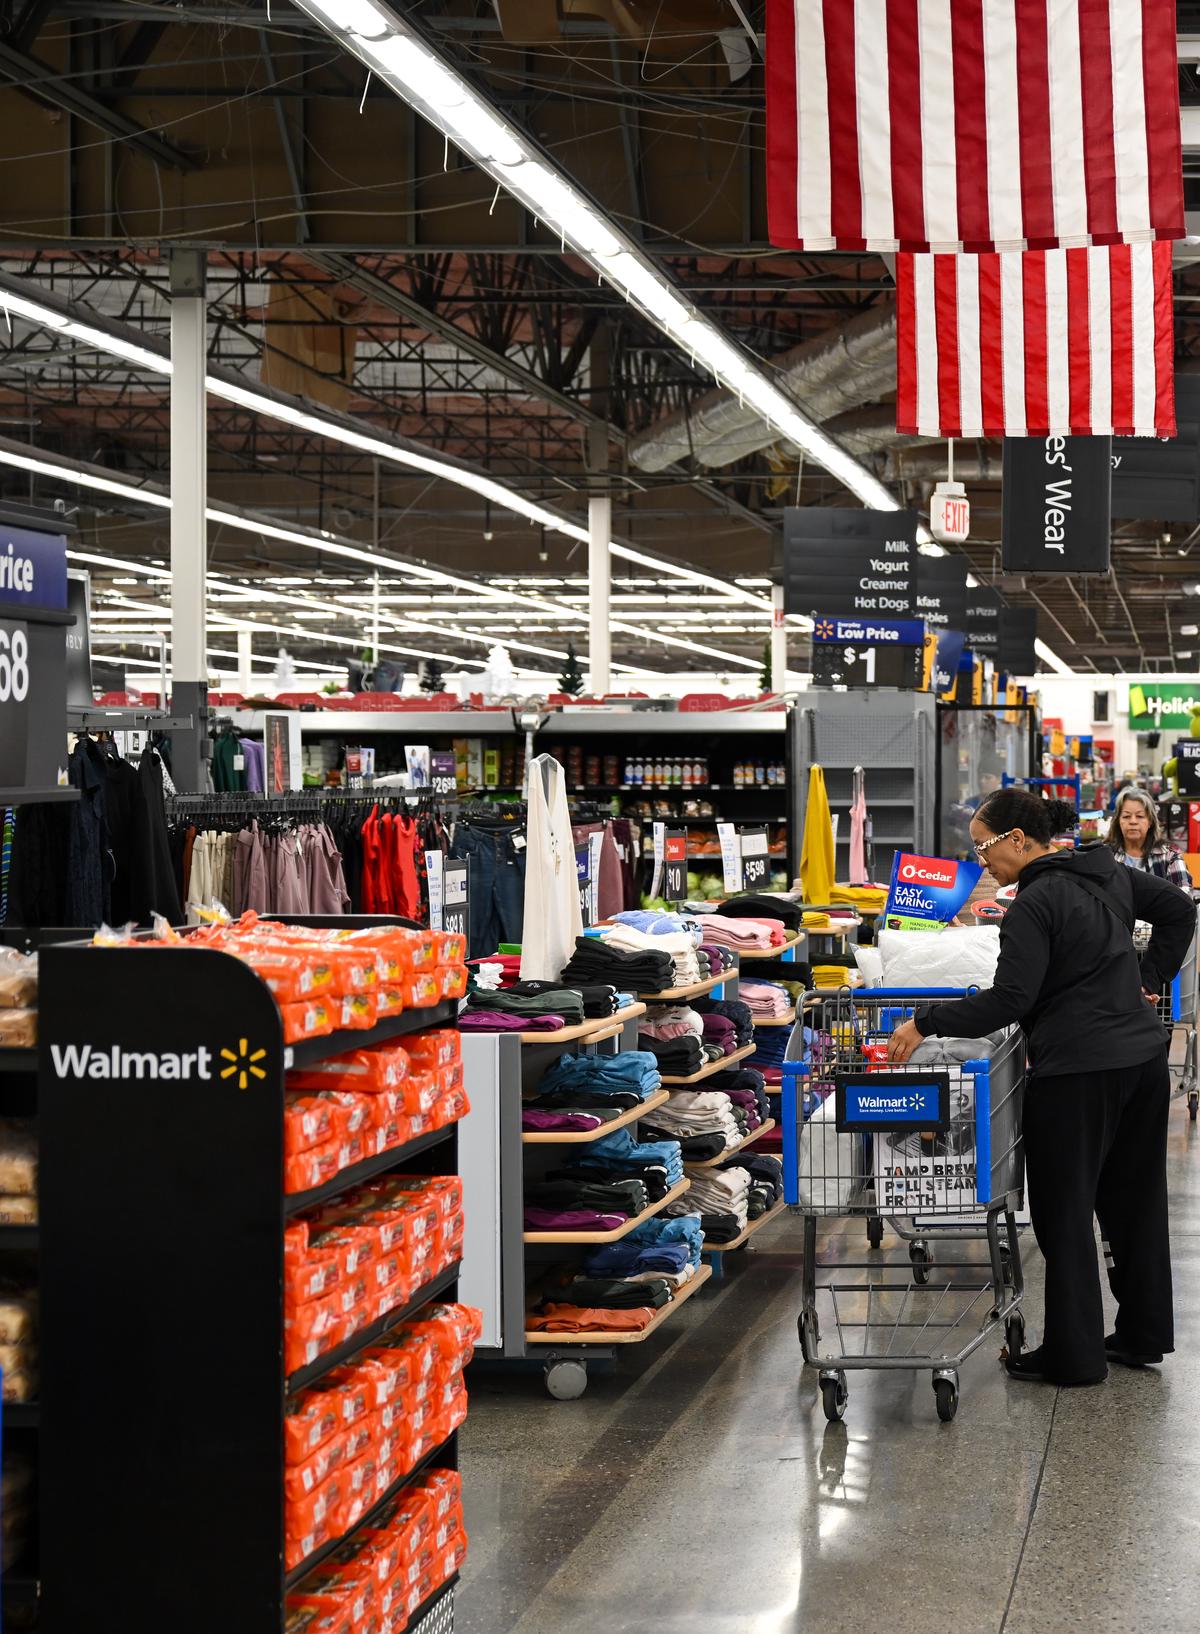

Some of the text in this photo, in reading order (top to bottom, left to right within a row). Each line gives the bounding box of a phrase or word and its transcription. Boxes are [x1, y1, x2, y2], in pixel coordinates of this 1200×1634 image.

[945, 501, 968, 534] EXIT
[1044, 479, 1073, 555] Wear
[884, 541, 910, 553] Milk
[870, 559, 909, 574] Yogurt
[859, 578, 909, 591] Creamer
[855, 597, 909, 612] Hot Dogs
[837, 628, 899, 640] Low Price
[896, 887, 923, 898] EASY
[51, 1044, 212, 1080] Walmart
[858, 1096, 907, 1108] Walmart
[884, 1165, 928, 1177] TAMP
